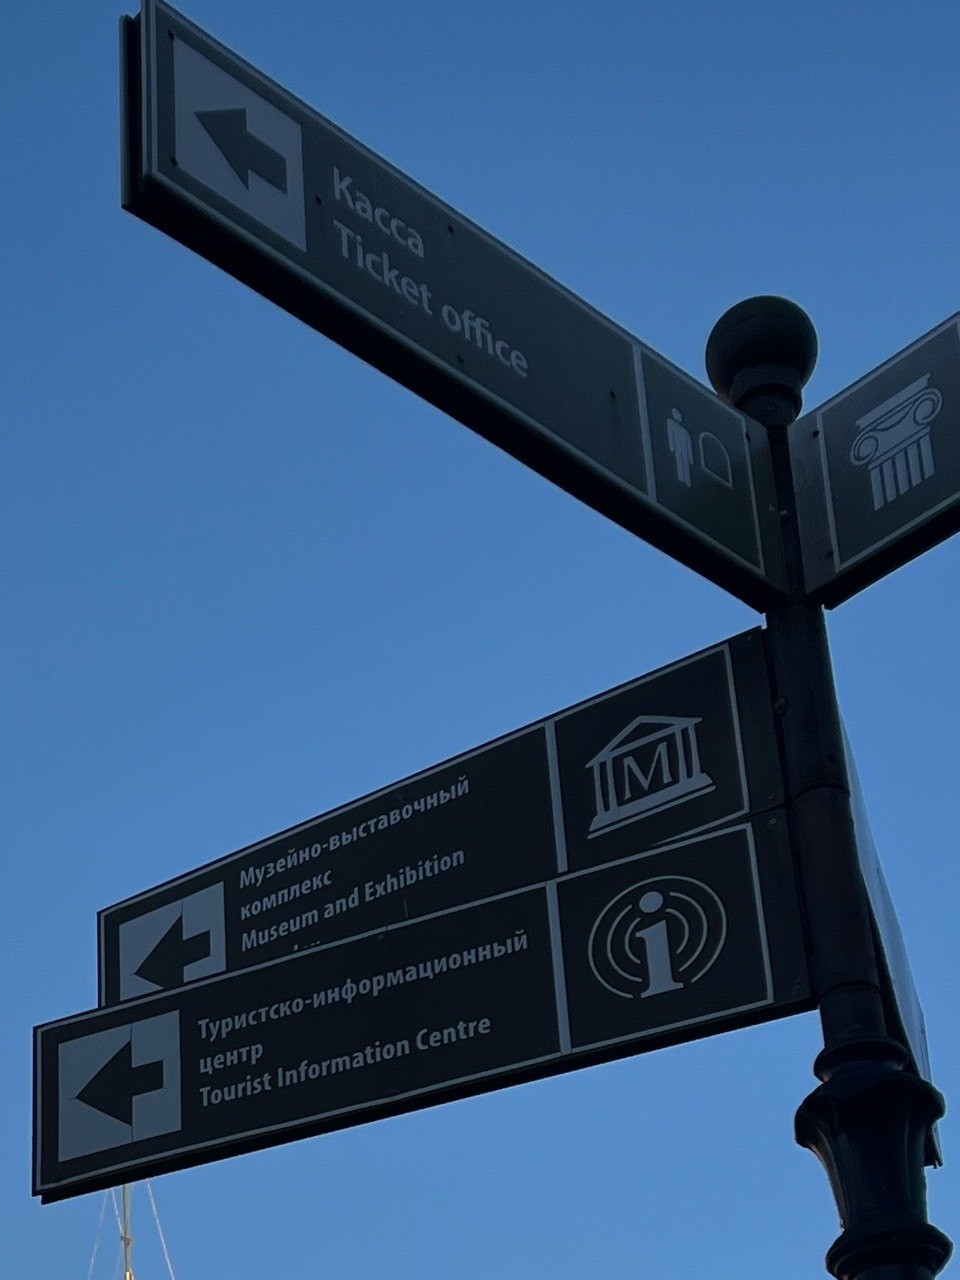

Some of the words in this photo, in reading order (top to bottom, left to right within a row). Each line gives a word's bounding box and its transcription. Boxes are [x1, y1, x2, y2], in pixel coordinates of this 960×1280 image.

[333, 166, 425, 258] Касса
[333, 218, 434, 316] Ticket
[441, 303, 529, 378] office
[239, 774, 470, 889] Музейно-выставочный
[240, 869, 333, 921] комплекс
[241, 908, 320, 952] Museum
[323, 886, 359, 919] and
[364, 850, 466, 902] Exhibition
[197, 928, 529, 1042] Туристско-информационный
[198, 1042, 264, 1076] центр
[199, 1074, 273, 1107] Tourist
[277, 1038, 411, 1089] Information
[415, 1016, 492, 1051] Centre
